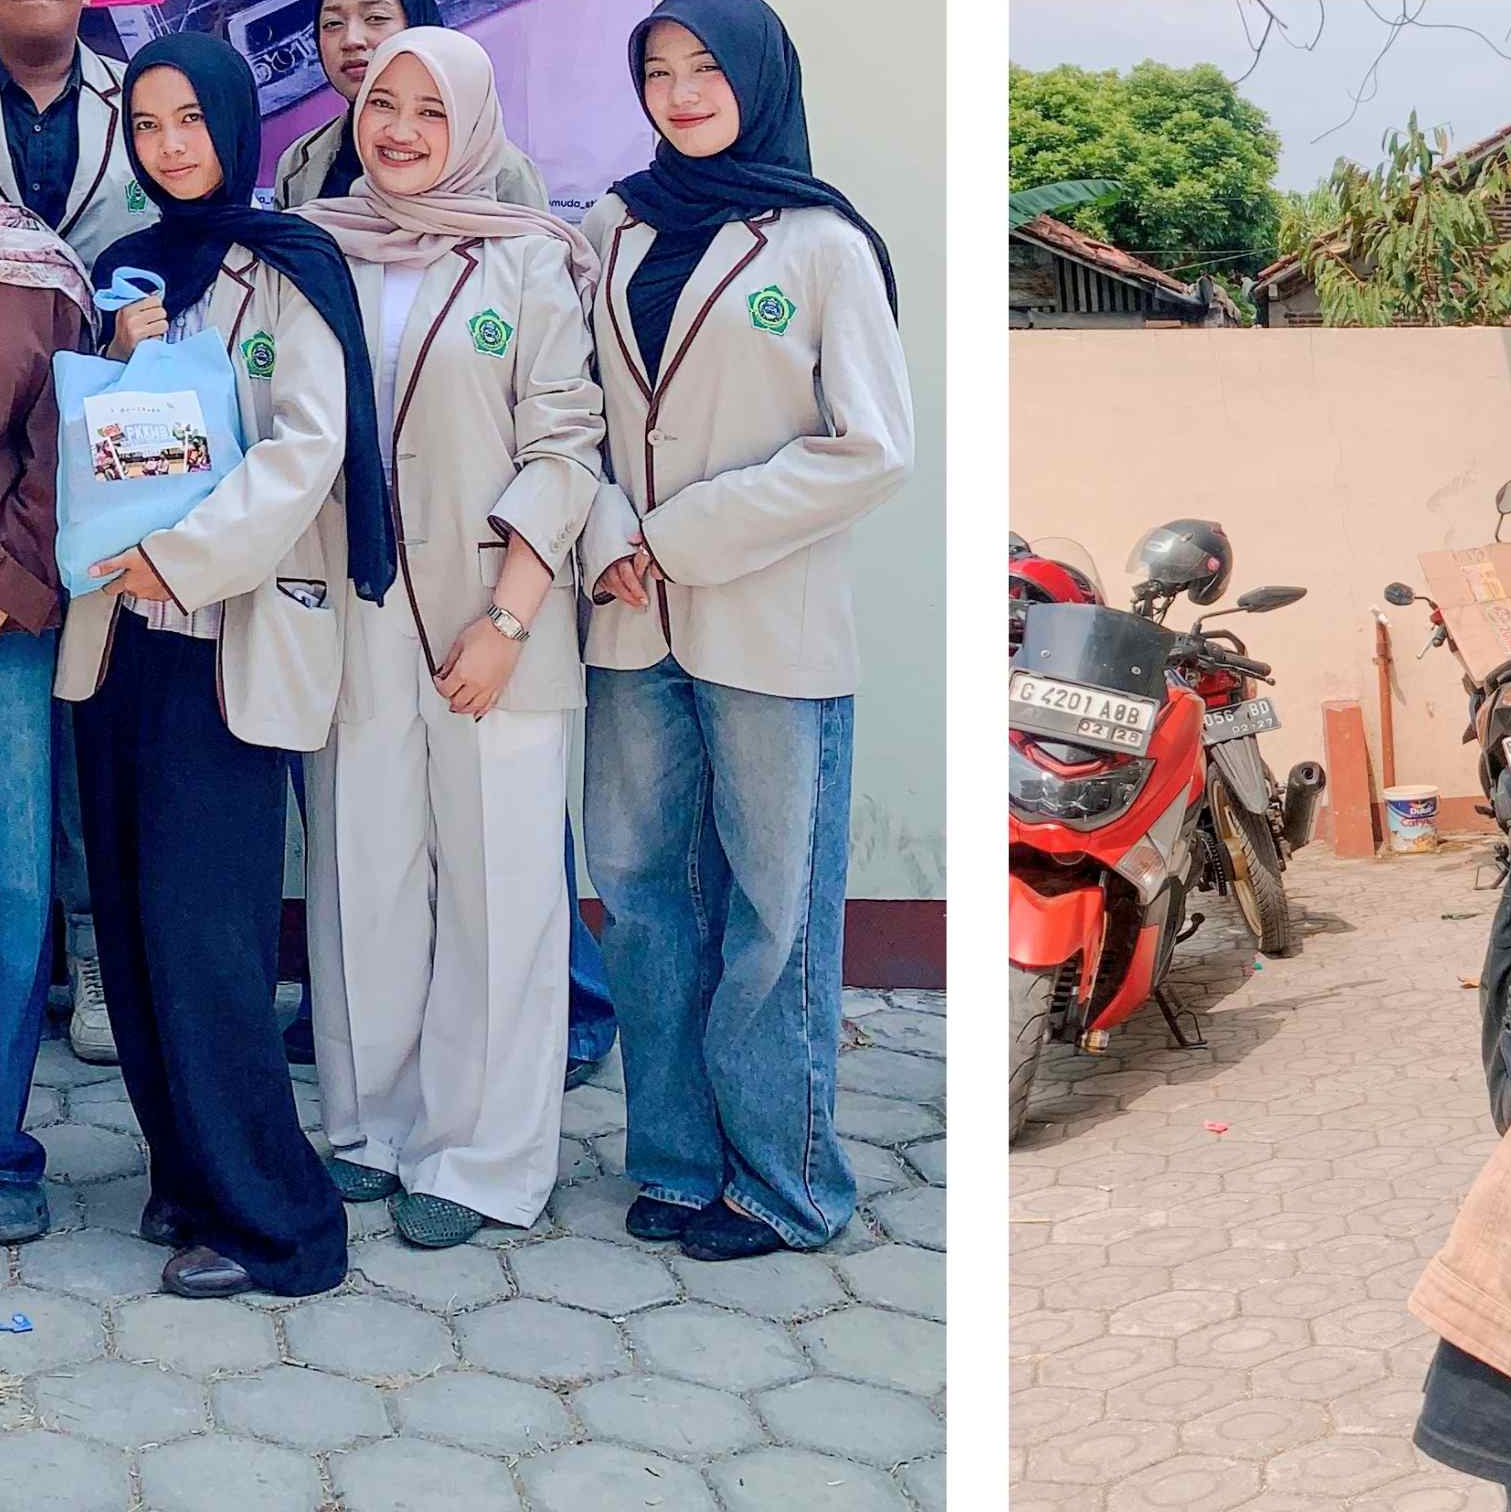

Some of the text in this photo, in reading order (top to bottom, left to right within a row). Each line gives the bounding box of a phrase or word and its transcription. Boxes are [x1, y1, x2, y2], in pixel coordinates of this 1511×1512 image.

[1041, 687, 1093, 714] 4201
[1203, 700, 1270, 727] 056 BD
